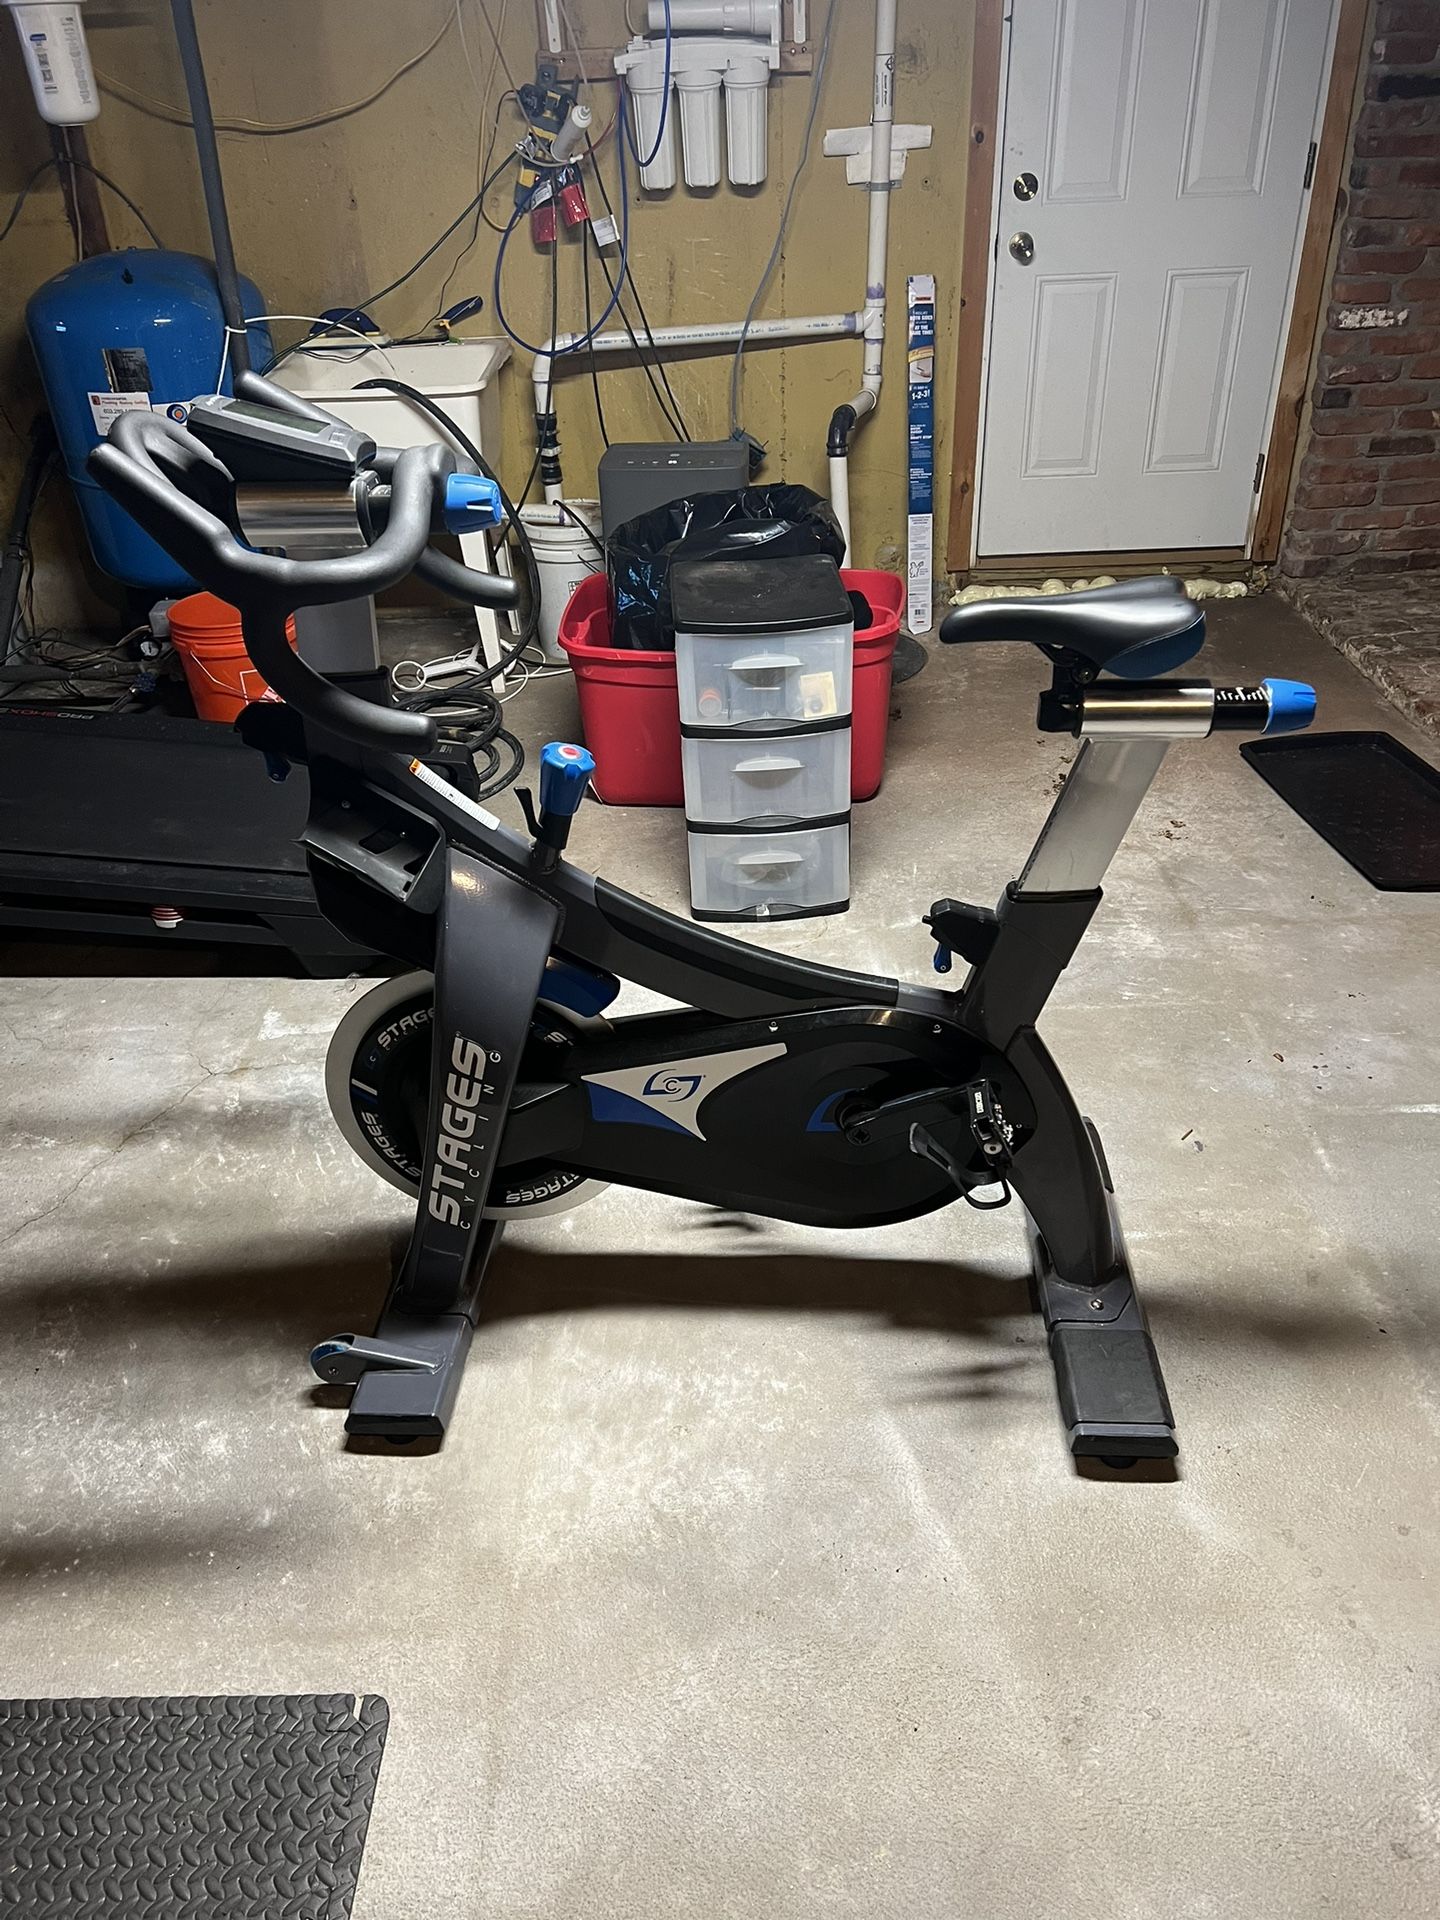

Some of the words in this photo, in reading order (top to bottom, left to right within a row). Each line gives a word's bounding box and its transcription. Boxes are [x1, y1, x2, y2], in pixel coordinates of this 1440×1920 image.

[911, 388, 931, 400] 1-2-3!
[361, 1111, 422, 1178] STAGES
[428, 1037, 488, 1226] STAGES
[460, 1051, 502, 1230] CYCLING
